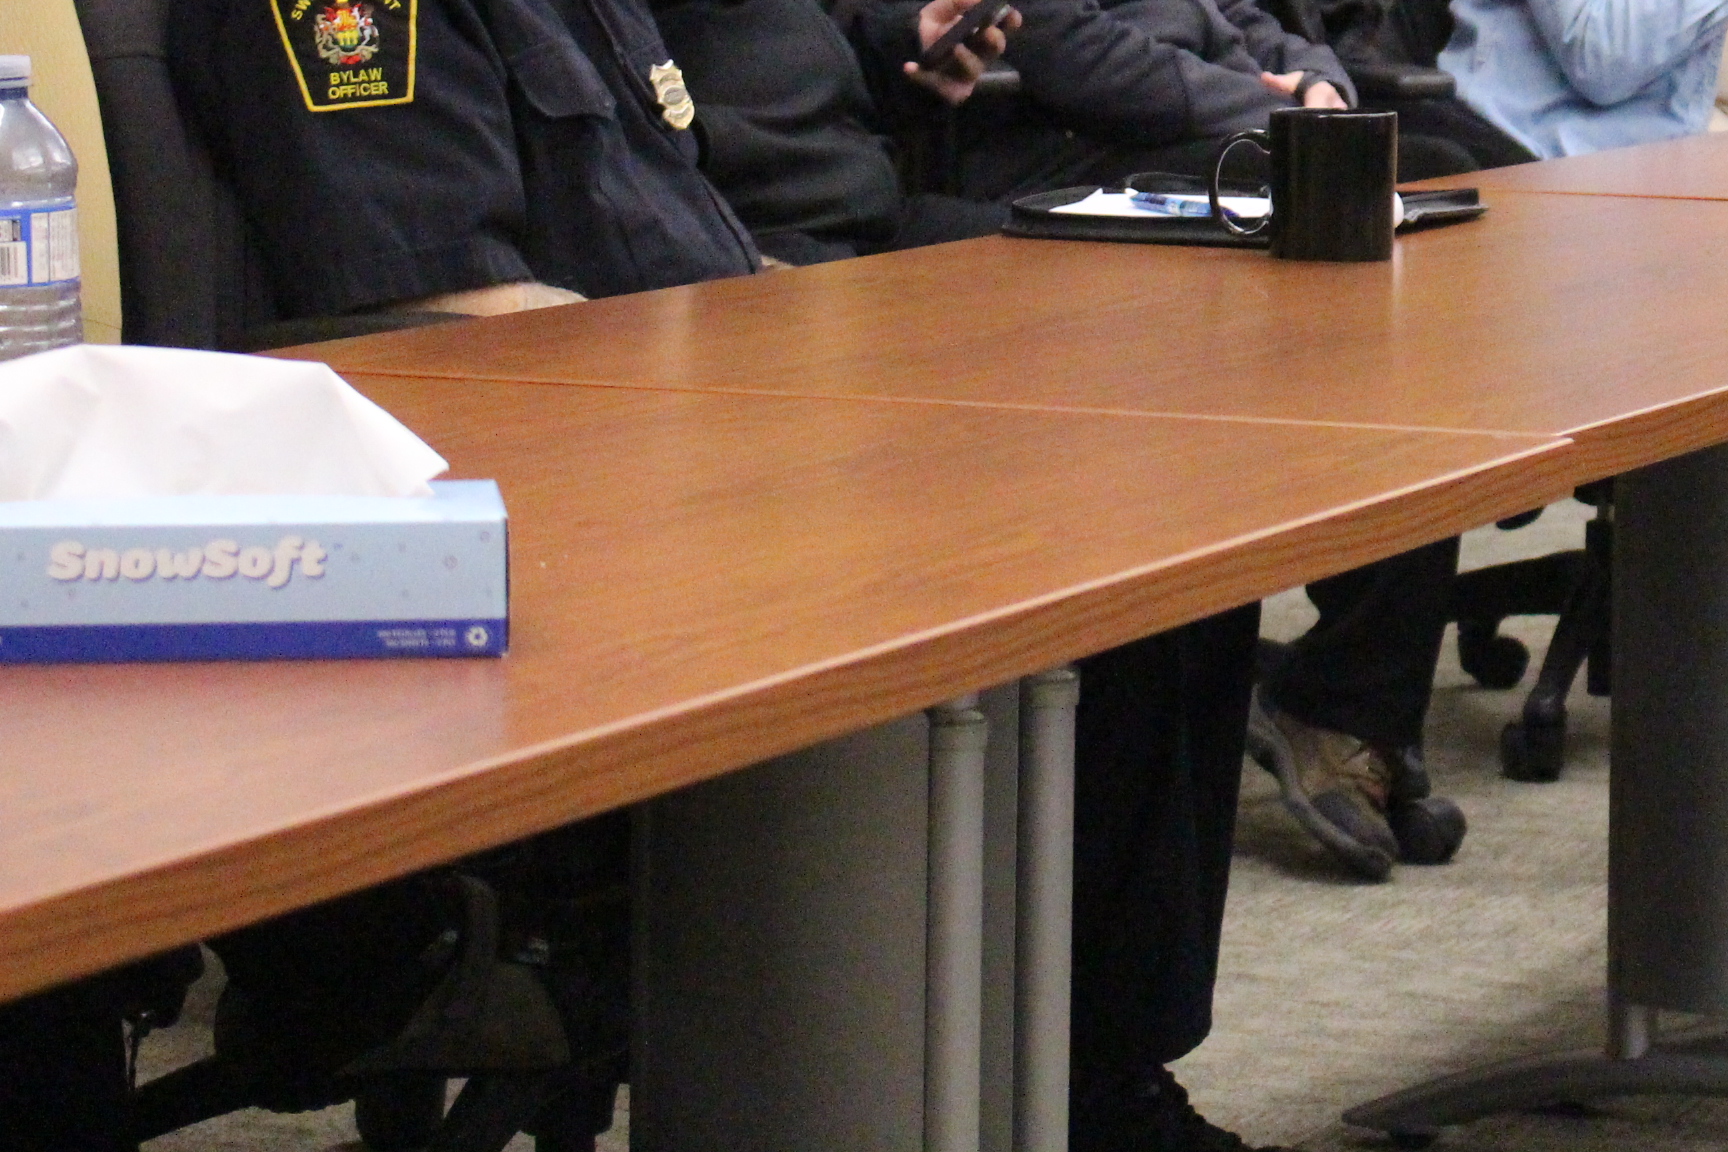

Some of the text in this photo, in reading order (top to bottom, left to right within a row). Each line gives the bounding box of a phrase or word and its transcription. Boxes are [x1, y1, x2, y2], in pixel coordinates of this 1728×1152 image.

[329, 67, 382, 84] BYLAW
[328, 81, 389, 99] OFFICER
[48, 535, 328, 590] SnowSoft
